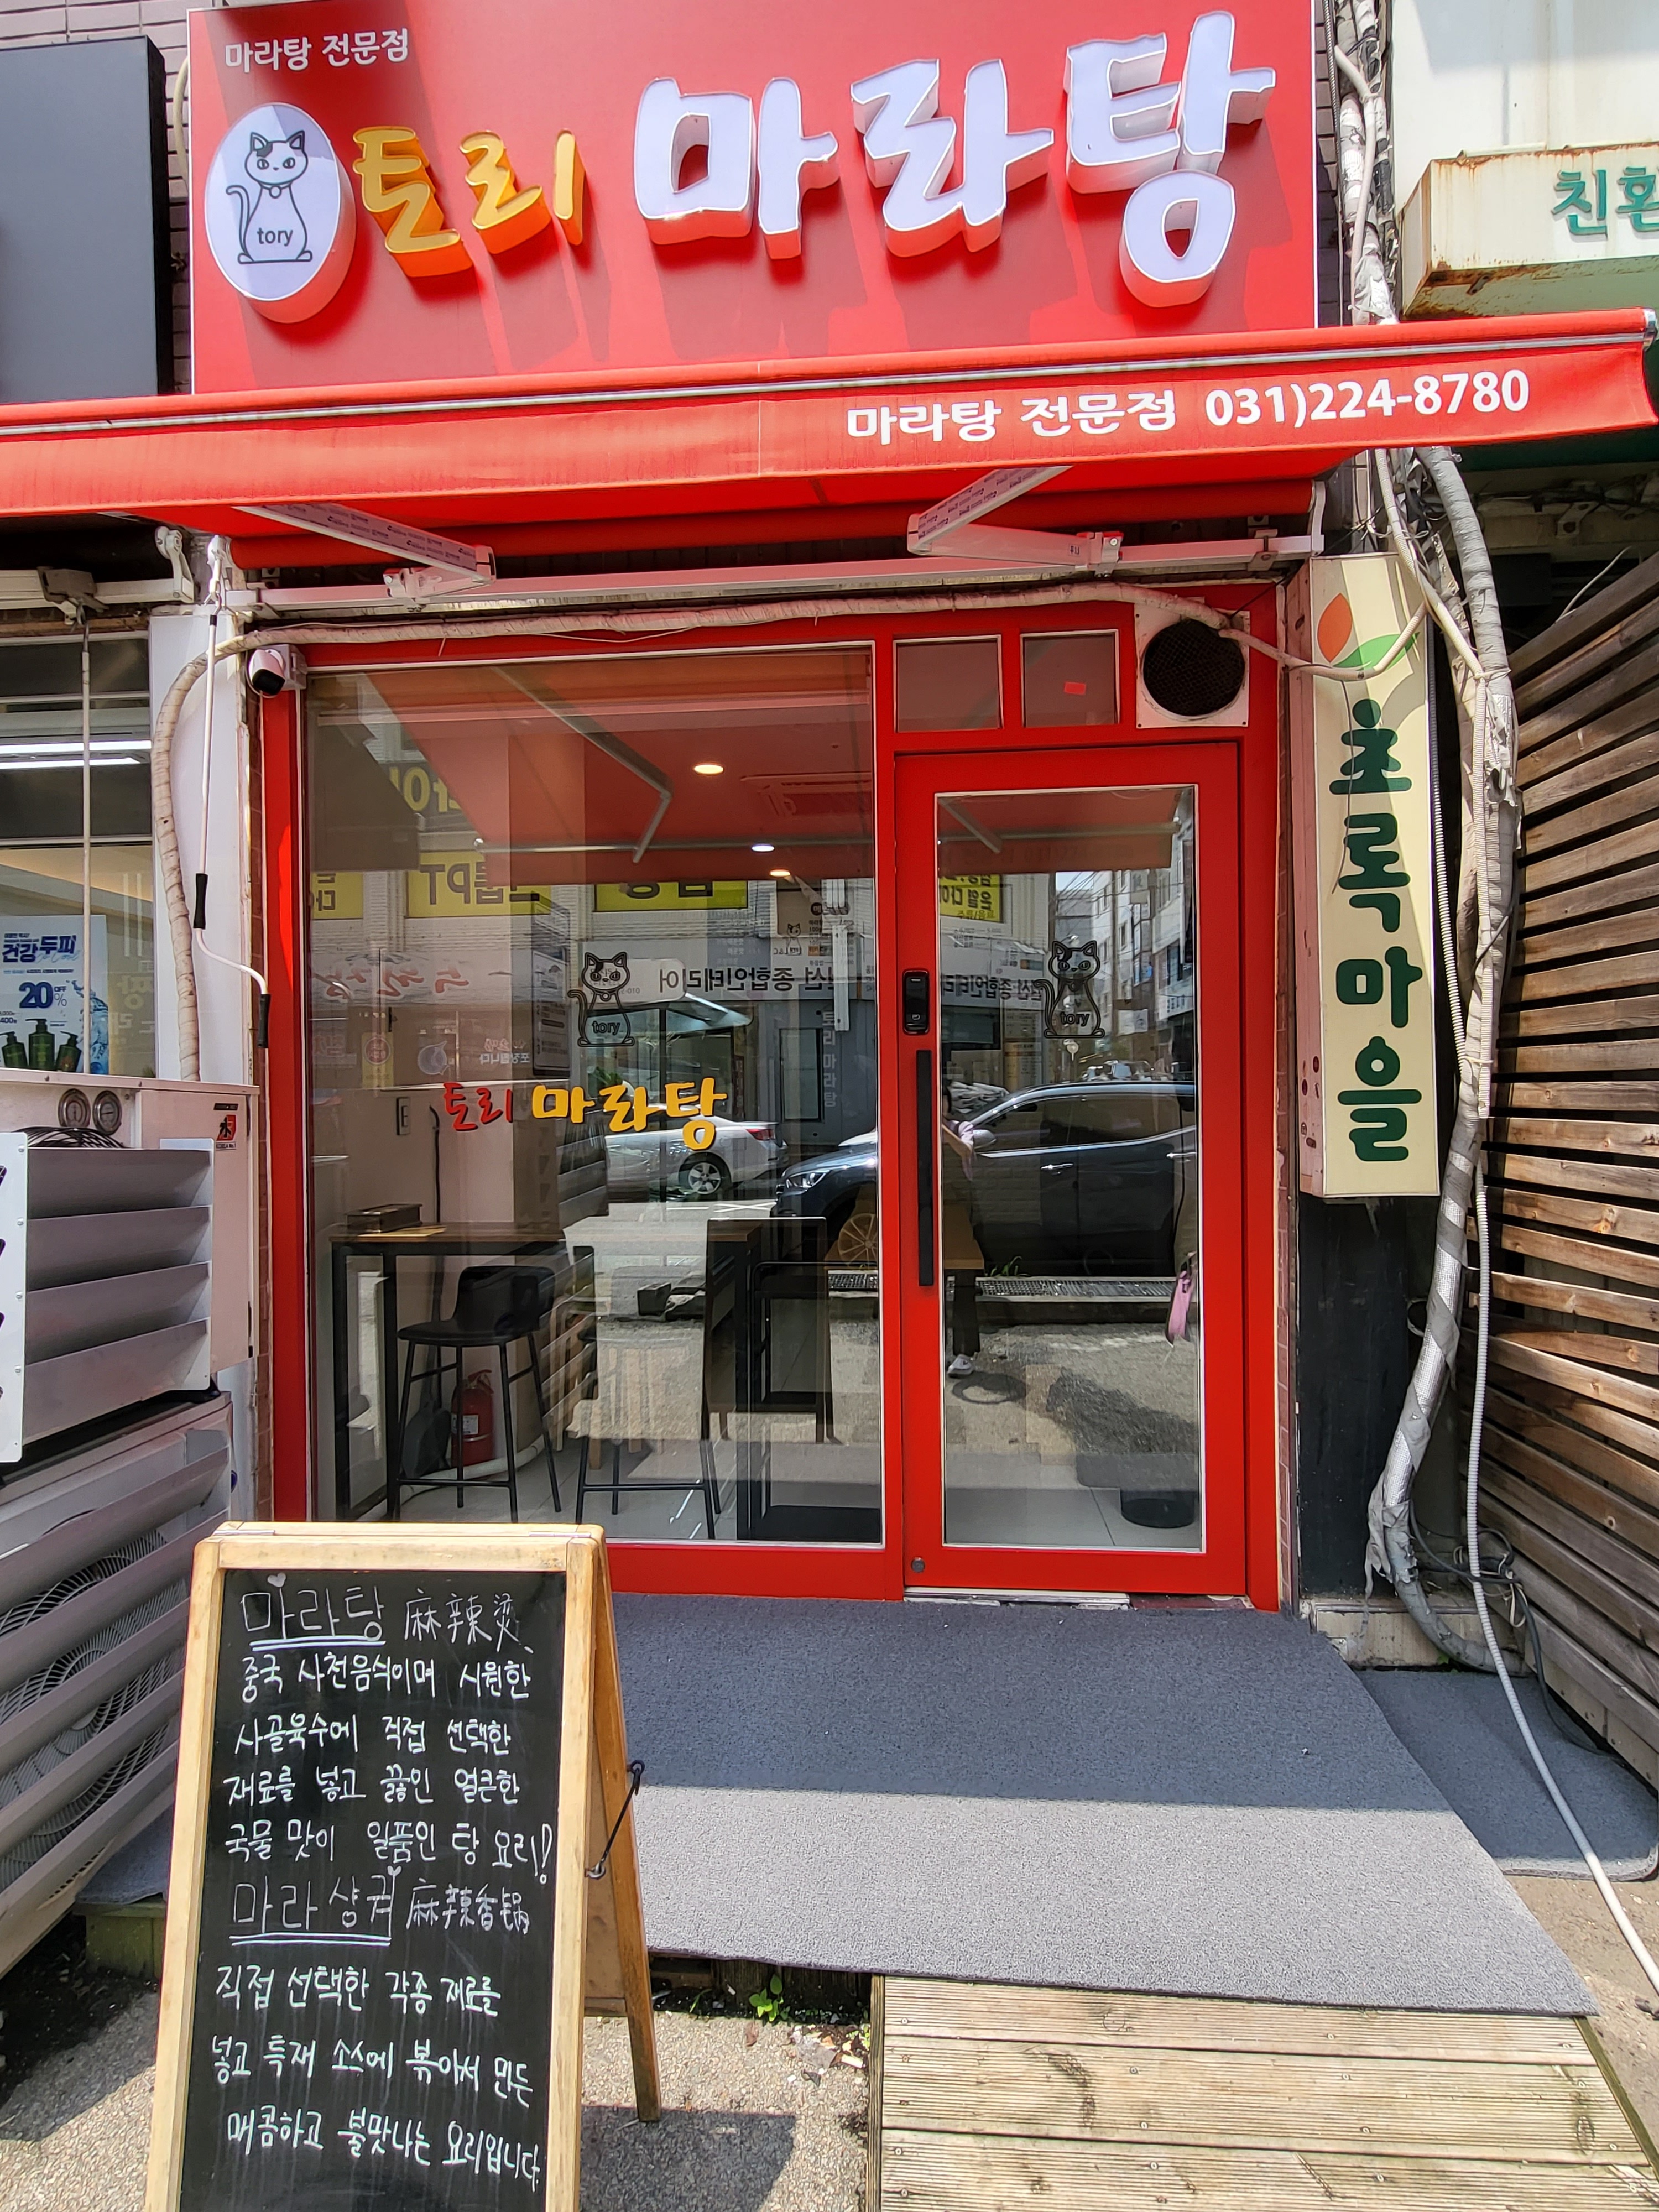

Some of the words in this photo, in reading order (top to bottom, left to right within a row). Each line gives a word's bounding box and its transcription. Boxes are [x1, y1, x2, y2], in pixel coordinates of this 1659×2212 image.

[225, 37, 311, 73] 마라탕
[322, 28, 409, 69] 전문점
[352, 126, 583, 271] 토리
[634, 11, 1276, 296] 마라탕
[257, 226, 294, 247] tory
[847, 397, 1001, 446] 마라탕
[1020, 389, 1176, 438] 전문점
[1205, 369, 1530, 428] 031)224-8780
[1329, 698, 1423, 1162] 초록마을
[19, 981, 54, 1009] 20
[1060, 1011, 1091, 1027] tory
[592, 1020, 620, 1036] tory
[443, 1082, 514, 1131] 토리
[532, 1077, 727, 1151] 마라탕
[241, 1585, 385, 1641] 마라탕
[242, 1653, 284, 1704] 중국
[298, 1651, 436, 1698] 사천음식이며
[460, 1660, 531, 1700] 시원한
[234, 1712, 359, 1755] 사골육수에
[382, 1715, 426, 1754] 직접
[447, 1717, 512, 1756] 선택한
[223, 1765, 296, 1806] 재료를
[316, 1766, 367, 1803] 넣고
[380, 1763, 434, 1803] 끓인
[225, 1819, 272, 1863] 국물
[286, 1819, 335, 1861] 맛이
[367, 1820, 437, 1864] 일품인
[451, 1822, 479, 1865] 탕
[216, 1965, 275, 2011] 직접
[287, 1965, 369, 2011] 선택한
[385, 1970, 432, 2016] 각종
[440, 1975, 502, 2017] 재료를
[212, 2034, 252, 2085] 넣고
[331, 2038, 394, 2079] 소스에
[494, 2056, 534, 2109] 만든
[227, 2105, 324, 2156] 매콤하고
[337, 2107, 431, 2167] 불맛나는
